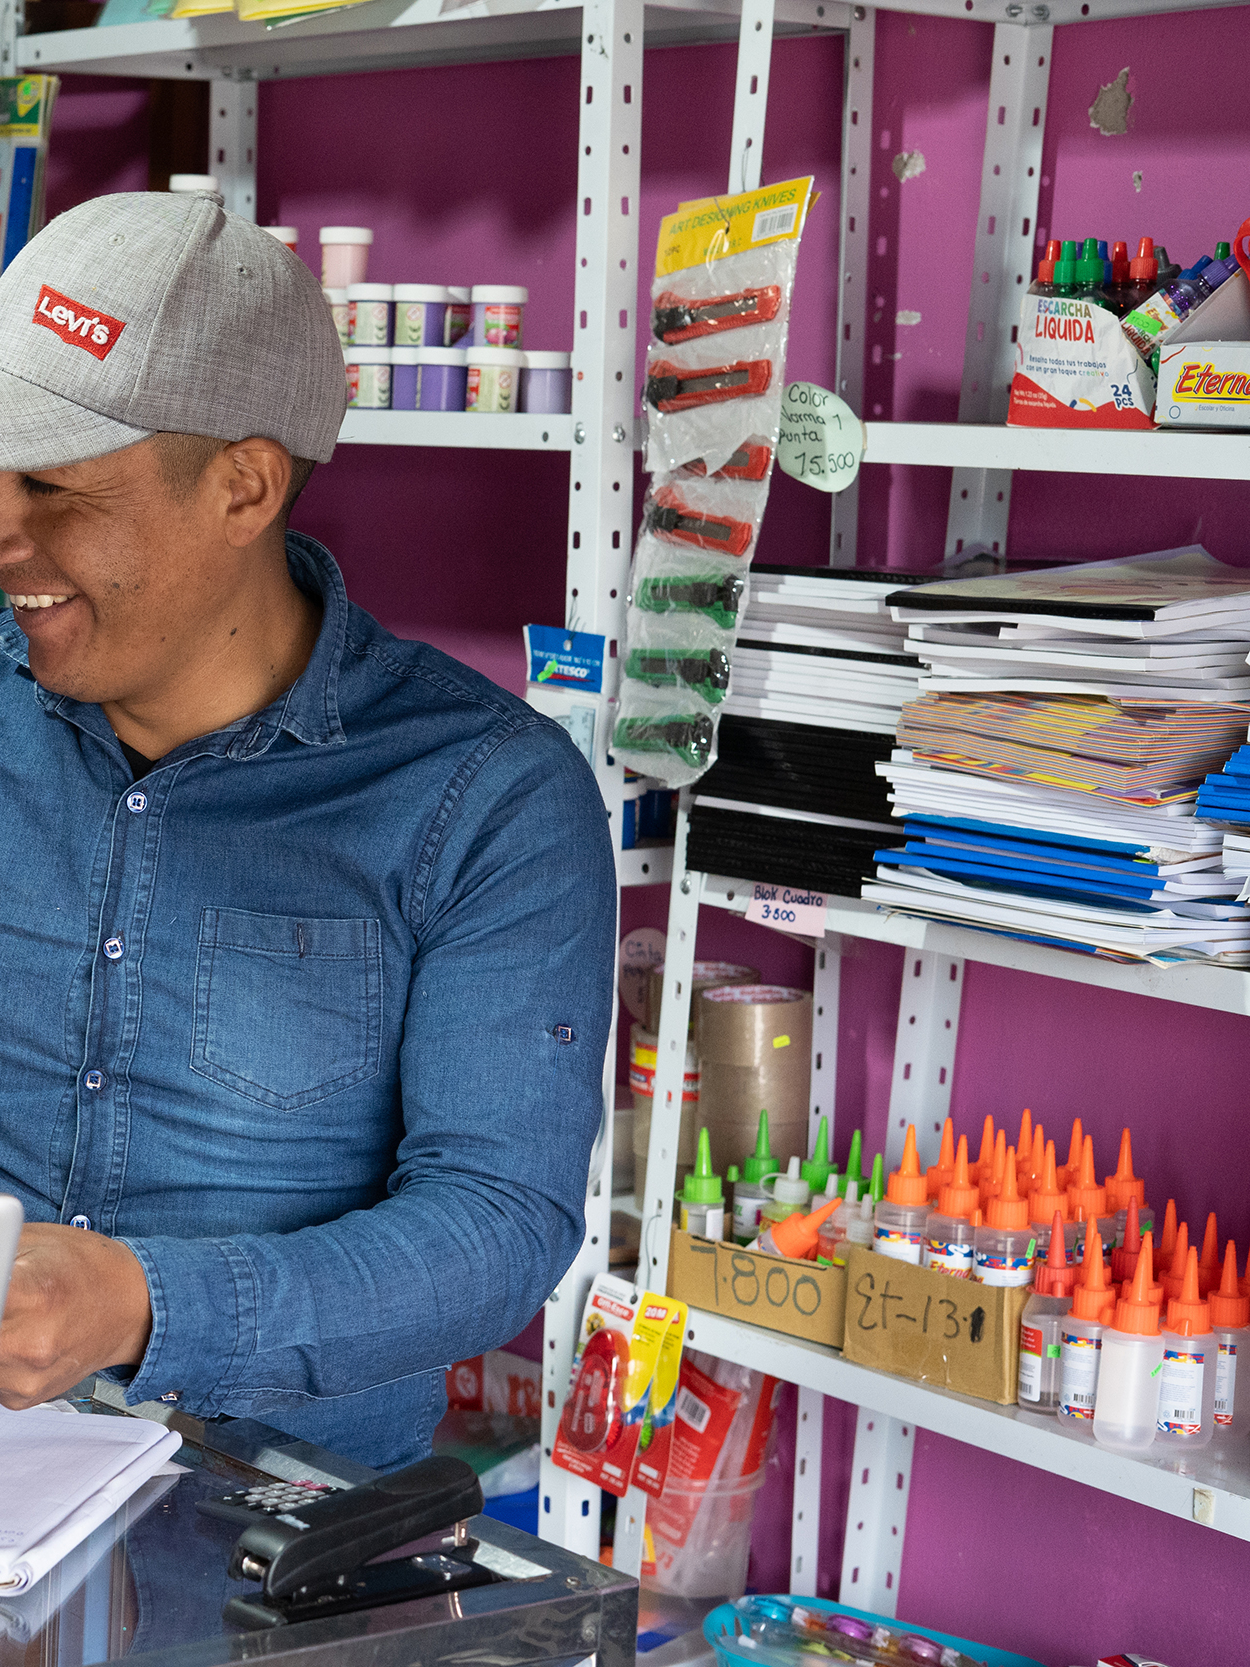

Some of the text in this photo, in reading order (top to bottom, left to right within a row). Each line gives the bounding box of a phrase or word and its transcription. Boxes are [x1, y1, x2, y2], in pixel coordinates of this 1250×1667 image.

[669, 220, 690, 236] ART
[752, 188, 797, 211] KNIVES
[1037, 298, 1092, 319] ESCARCHA
[37, 295, 111, 346] Levi's
[1043, 366, 1058, 375] gran
[1058, 368, 1077, 377] toque
[1077, 360, 1107, 369] trabajos
[788, 383, 829, 408] Color
[1110, 384, 1133, 397] 24
[794, 451, 855, 477] 15.500
[783, 889, 823, 907] Cuadro
[689, 1244, 822, 1317] 7.800
